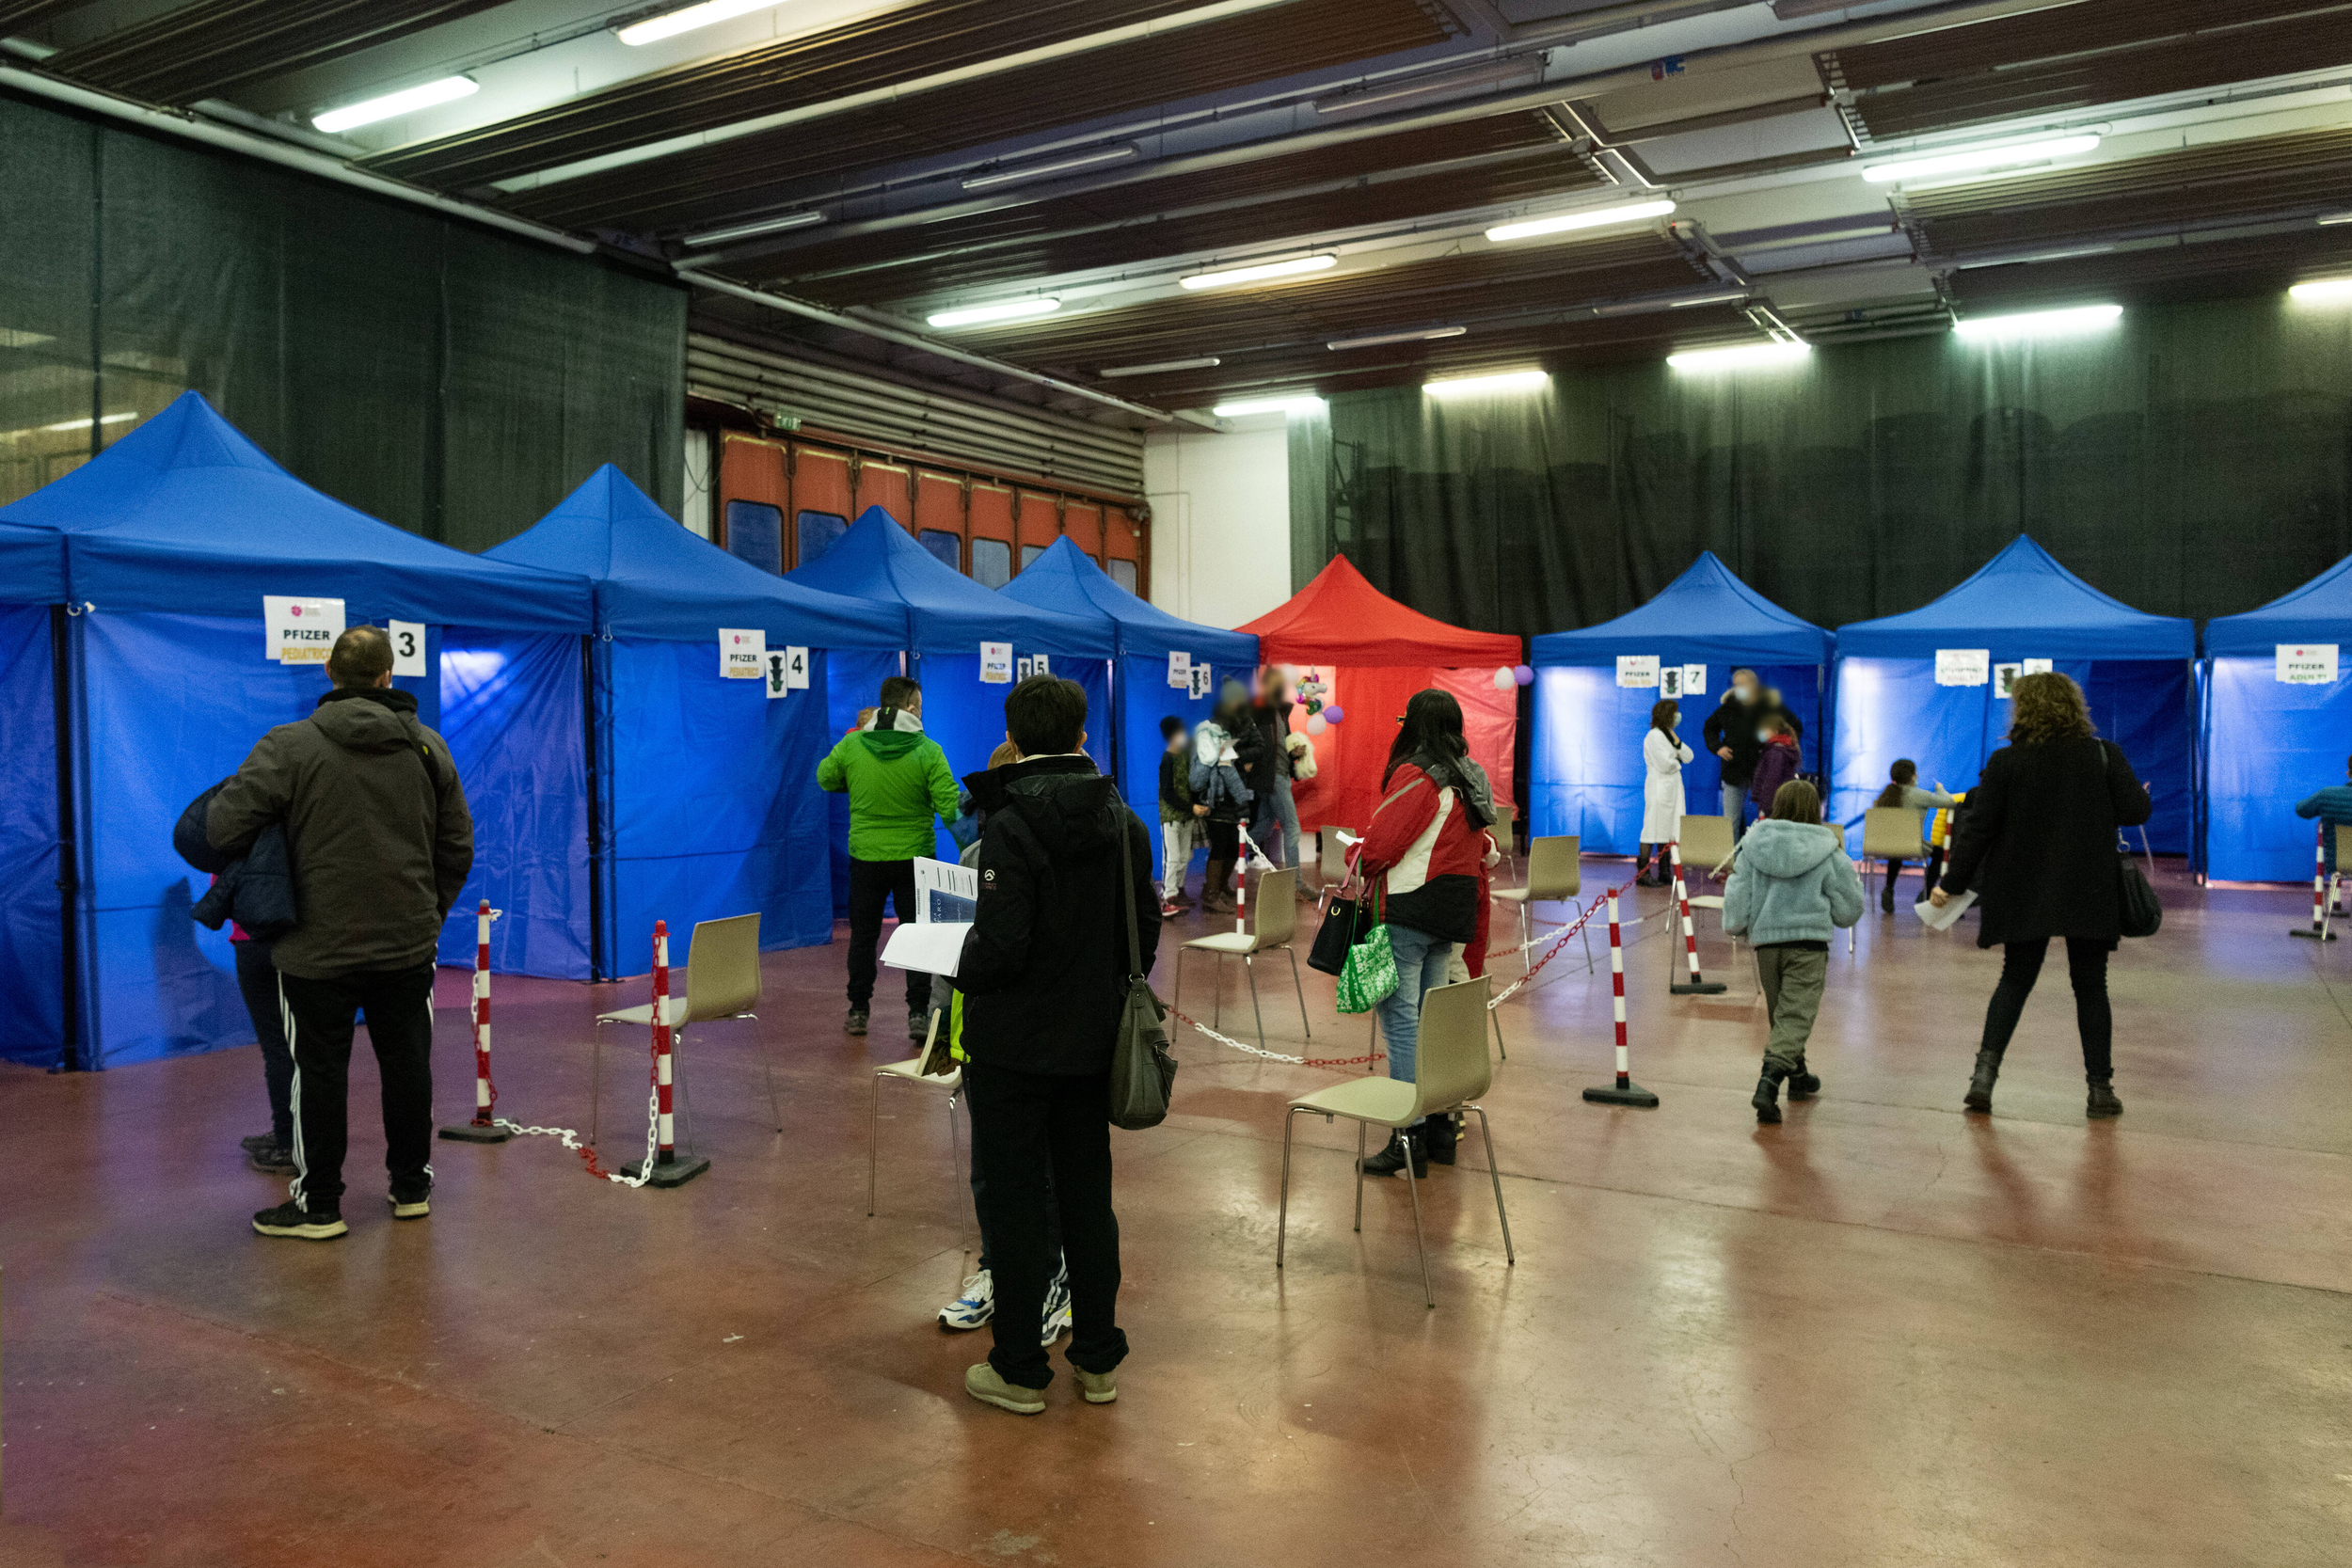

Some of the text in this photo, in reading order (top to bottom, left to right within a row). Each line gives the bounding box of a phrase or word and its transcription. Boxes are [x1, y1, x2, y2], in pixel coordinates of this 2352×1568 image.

[283, 629, 330, 641] PFIZER
[399, 632, 415, 657] 3
[730, 654, 757, 662] PFIZER
[791, 654, 803, 674] 4
[1038, 661, 1044, 675] 5
[1203, 671, 1209, 686] 6
[1691, 671, 1700, 684] 7
